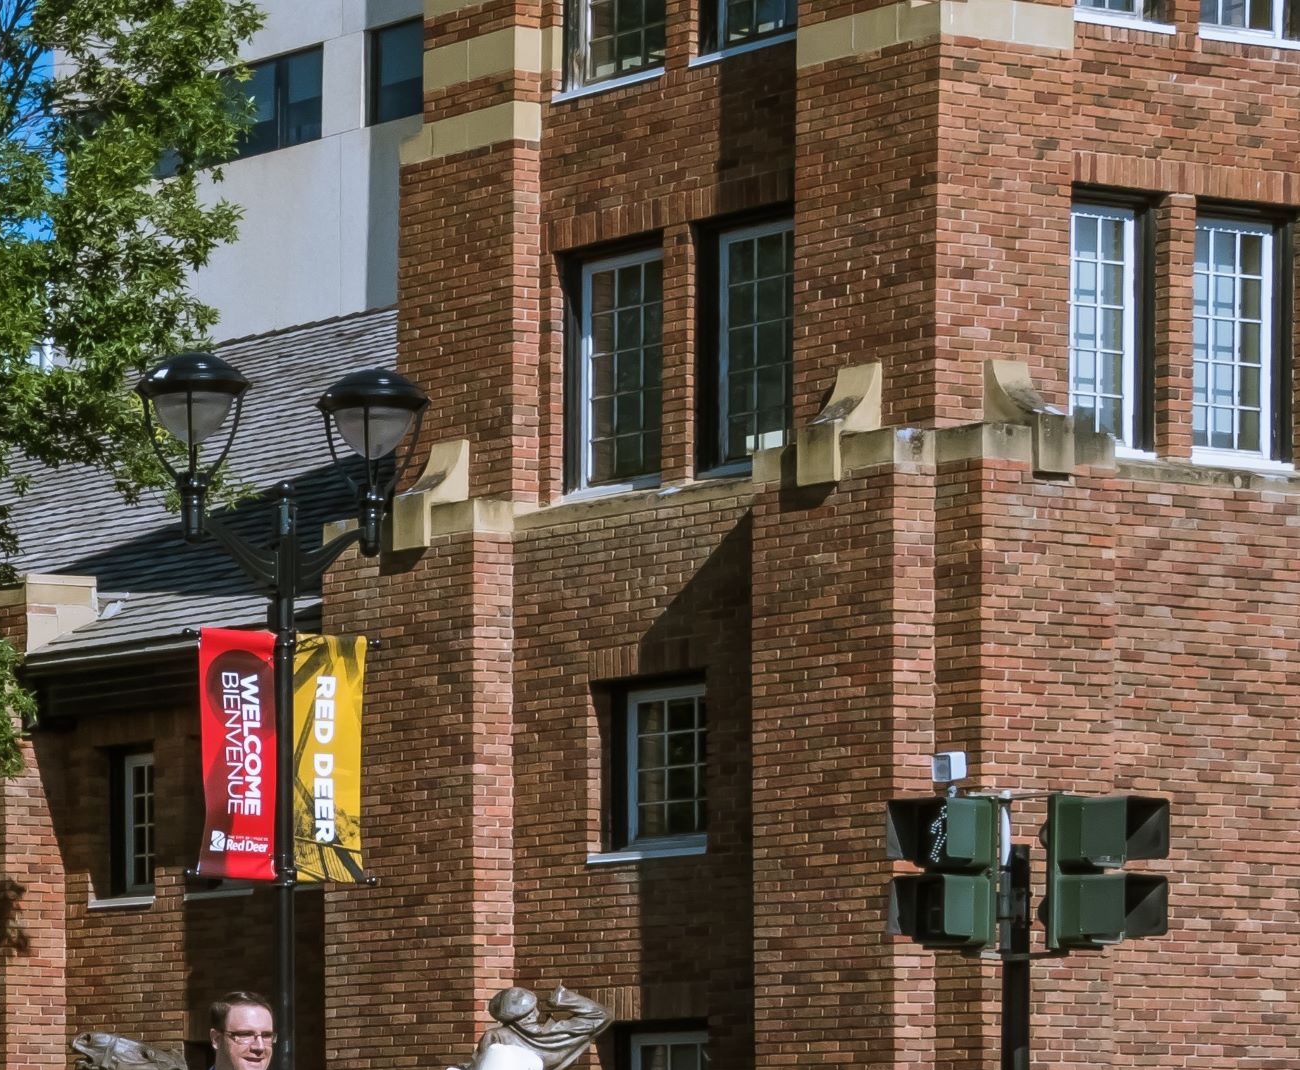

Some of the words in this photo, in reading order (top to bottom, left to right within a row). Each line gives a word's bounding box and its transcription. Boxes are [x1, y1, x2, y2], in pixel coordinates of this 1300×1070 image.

[221, 671, 244, 815] BIENVENUE
[240, 674, 262, 817] WELCOME
[314, 675, 337, 744] RED
[313, 753, 336, 843] DEER
[226, 838, 245, 851] Red
[246, 840, 269, 853] Deer
